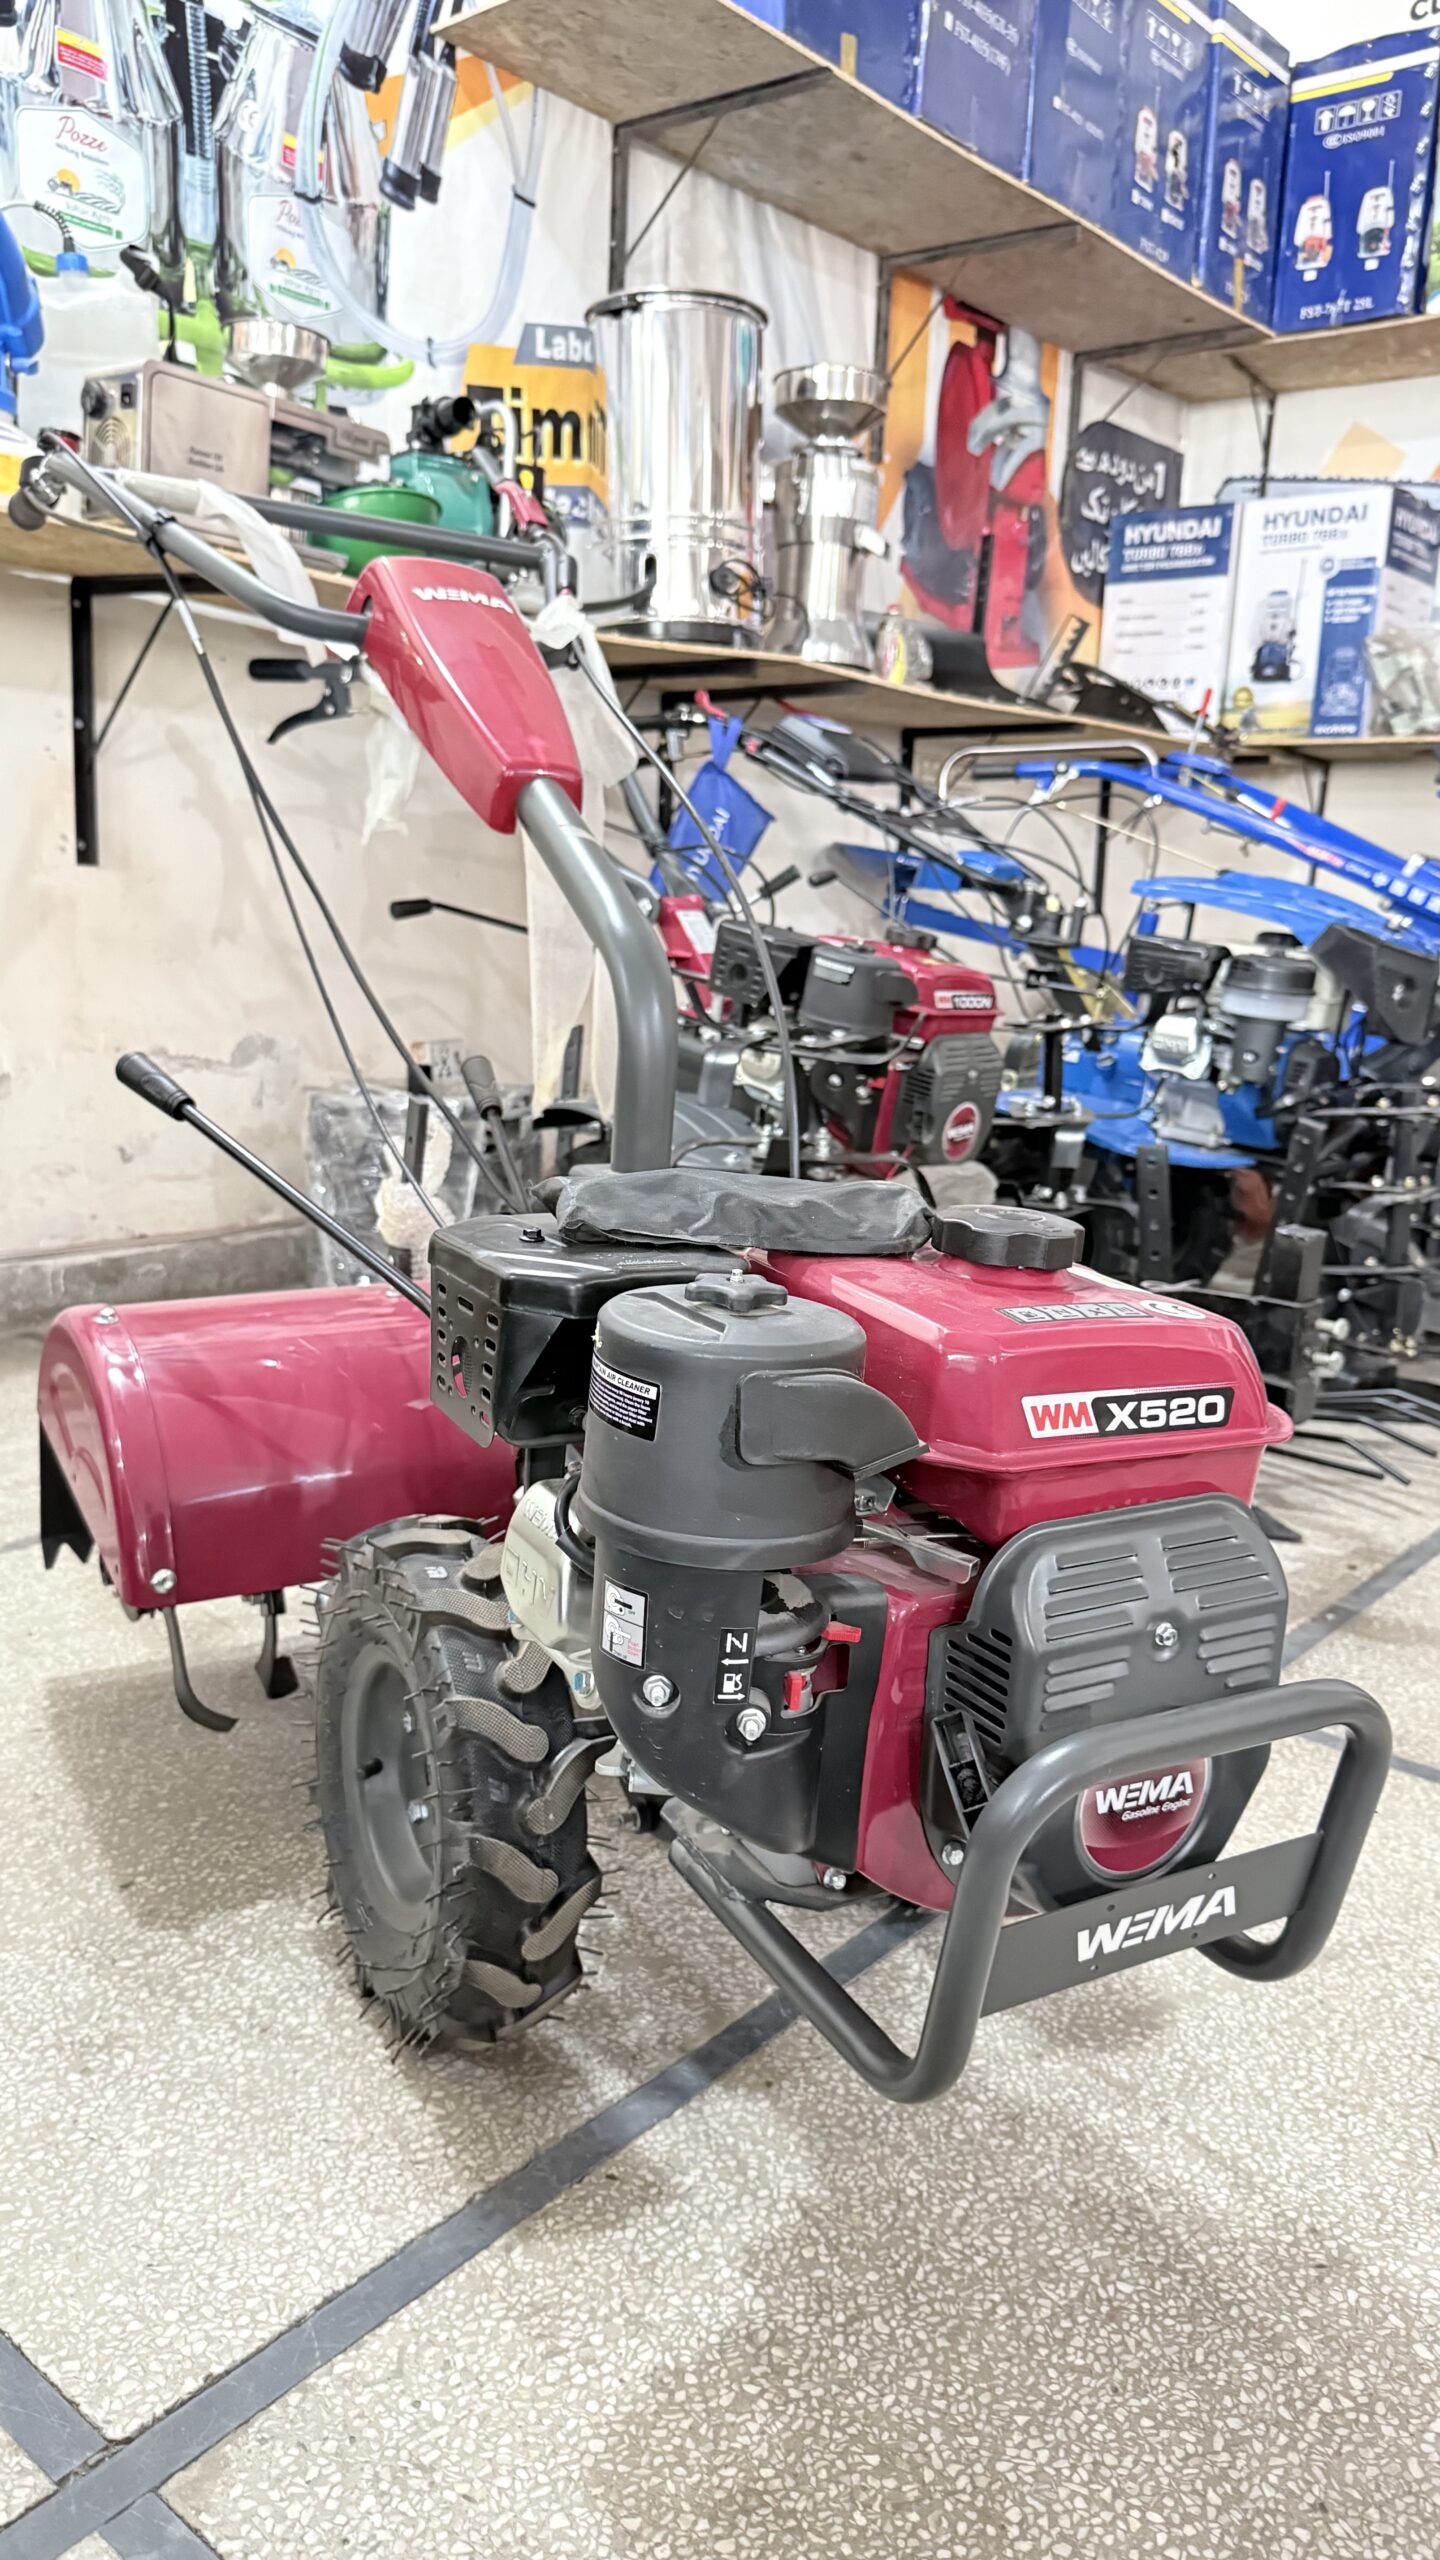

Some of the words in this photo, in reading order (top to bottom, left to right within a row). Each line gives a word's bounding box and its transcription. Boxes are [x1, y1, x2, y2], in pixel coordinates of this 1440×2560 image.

[1124, 516, 1223, 547] HYUNDAI
[1263, 504, 1369, 531] HYUNDAI
[412, 587, 515, 615] WEMA
[606, 1371, 617, 1381] AIR
[617, 1377, 651, 1396] CLEANER
[1030, 1401, 1093, 1432] WM
[1104, 1394, 1225, 1432] X520
[1095, 1771, 1194, 1815] WEMA
[1121, 1805, 1161, 1822] Gasoline
[1161, 1798, 1192, 1813] Engine
[1077, 1885, 1237, 1963] WEMA
